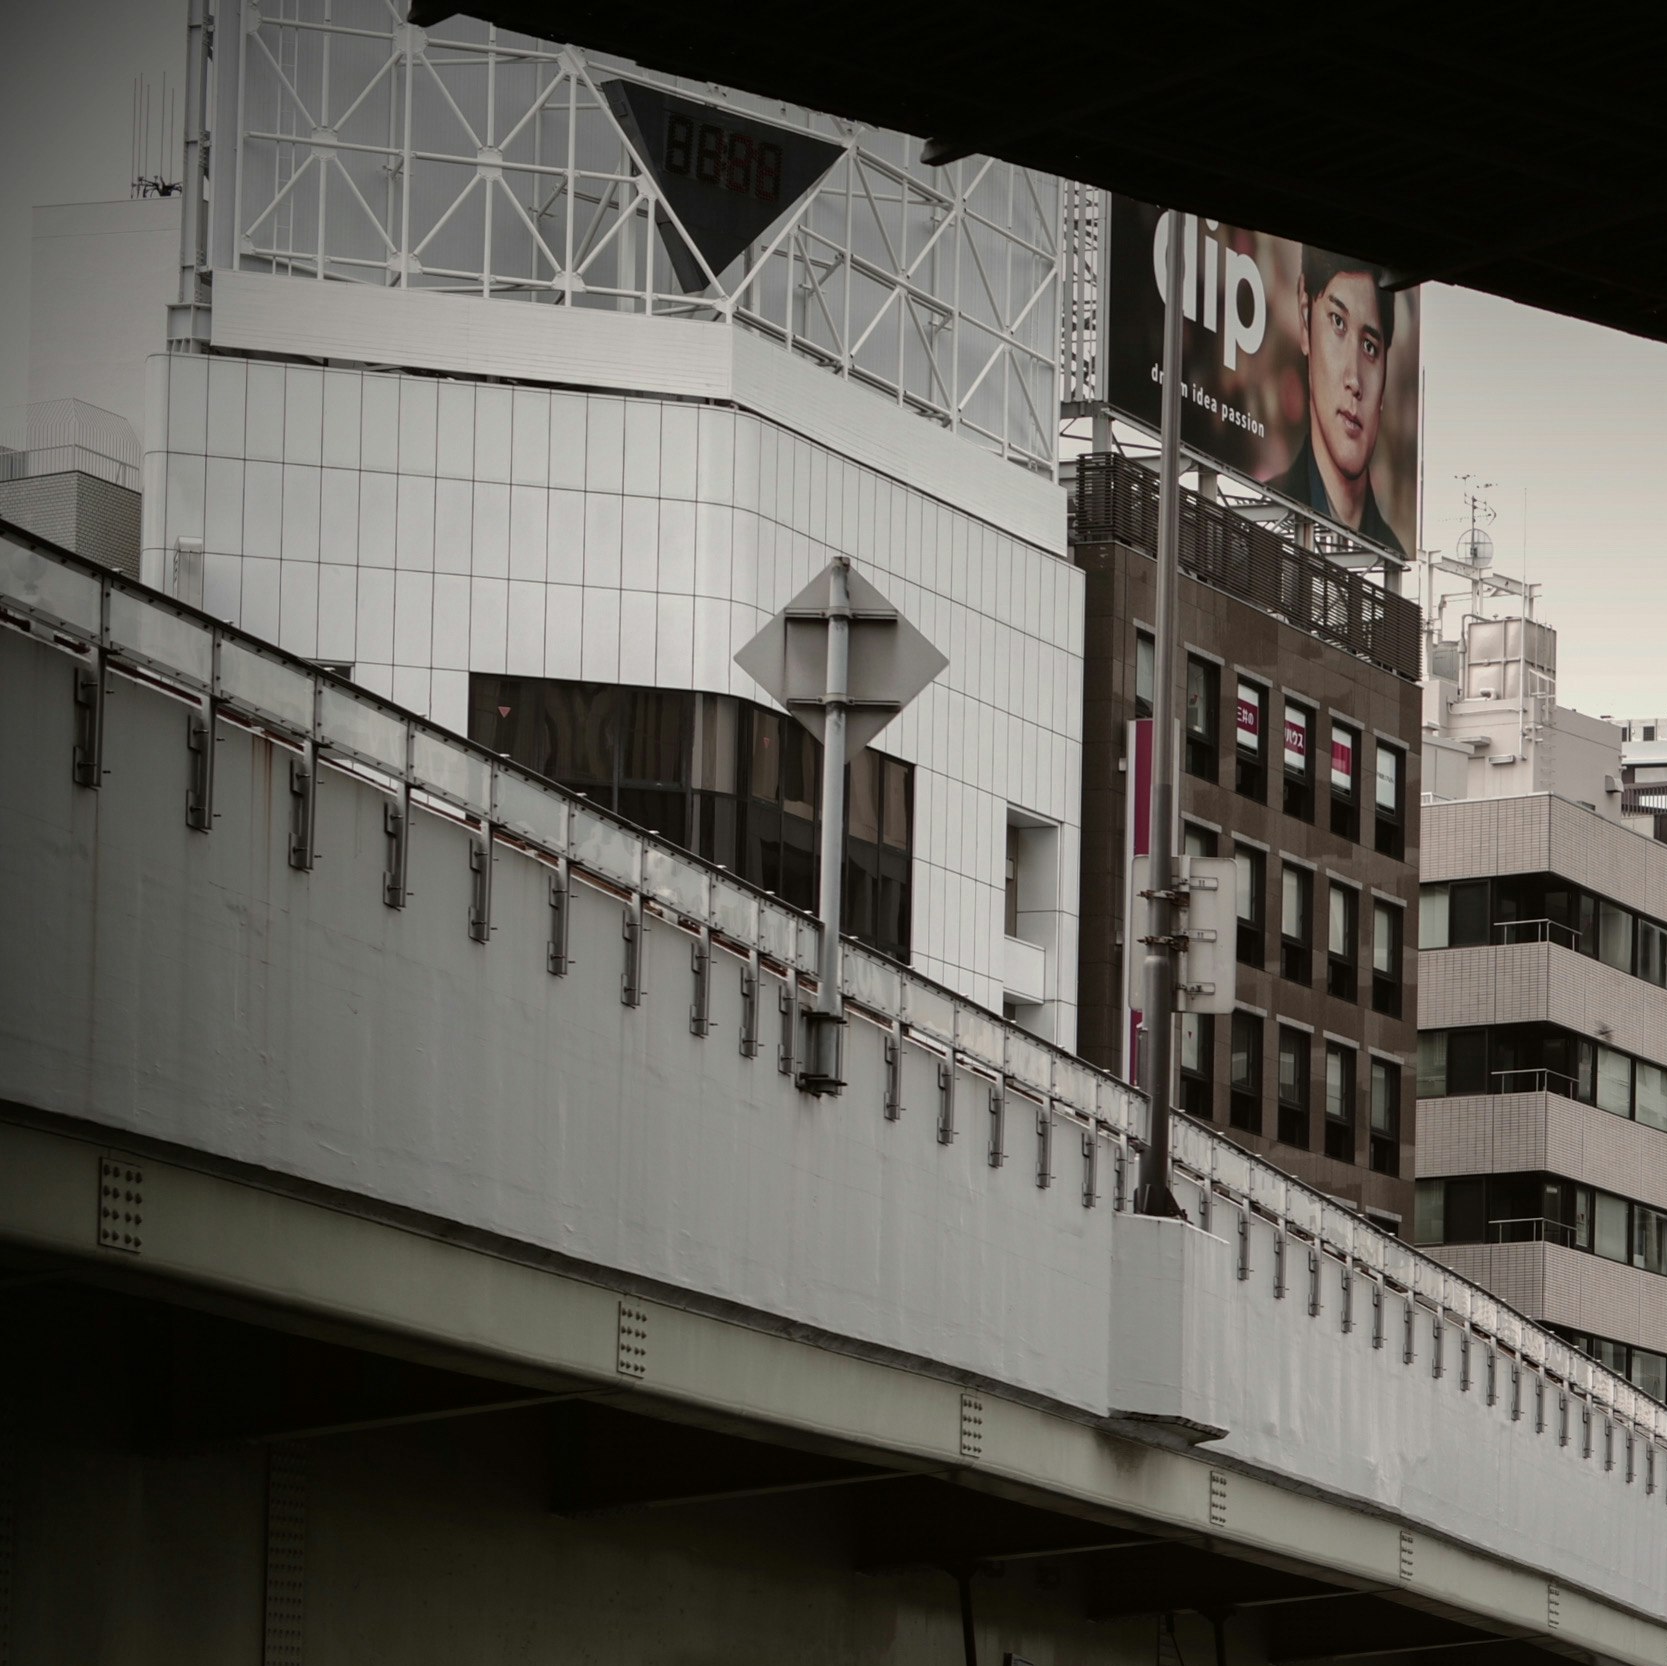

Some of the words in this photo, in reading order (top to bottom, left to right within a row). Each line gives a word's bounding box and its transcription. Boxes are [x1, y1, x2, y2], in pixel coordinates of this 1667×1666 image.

[1153, 207, 1267, 372] dip
[1151, 362, 1188, 398] drm
[1192, 383, 1217, 414] idea
[1221, 403, 1264, 439] passion
